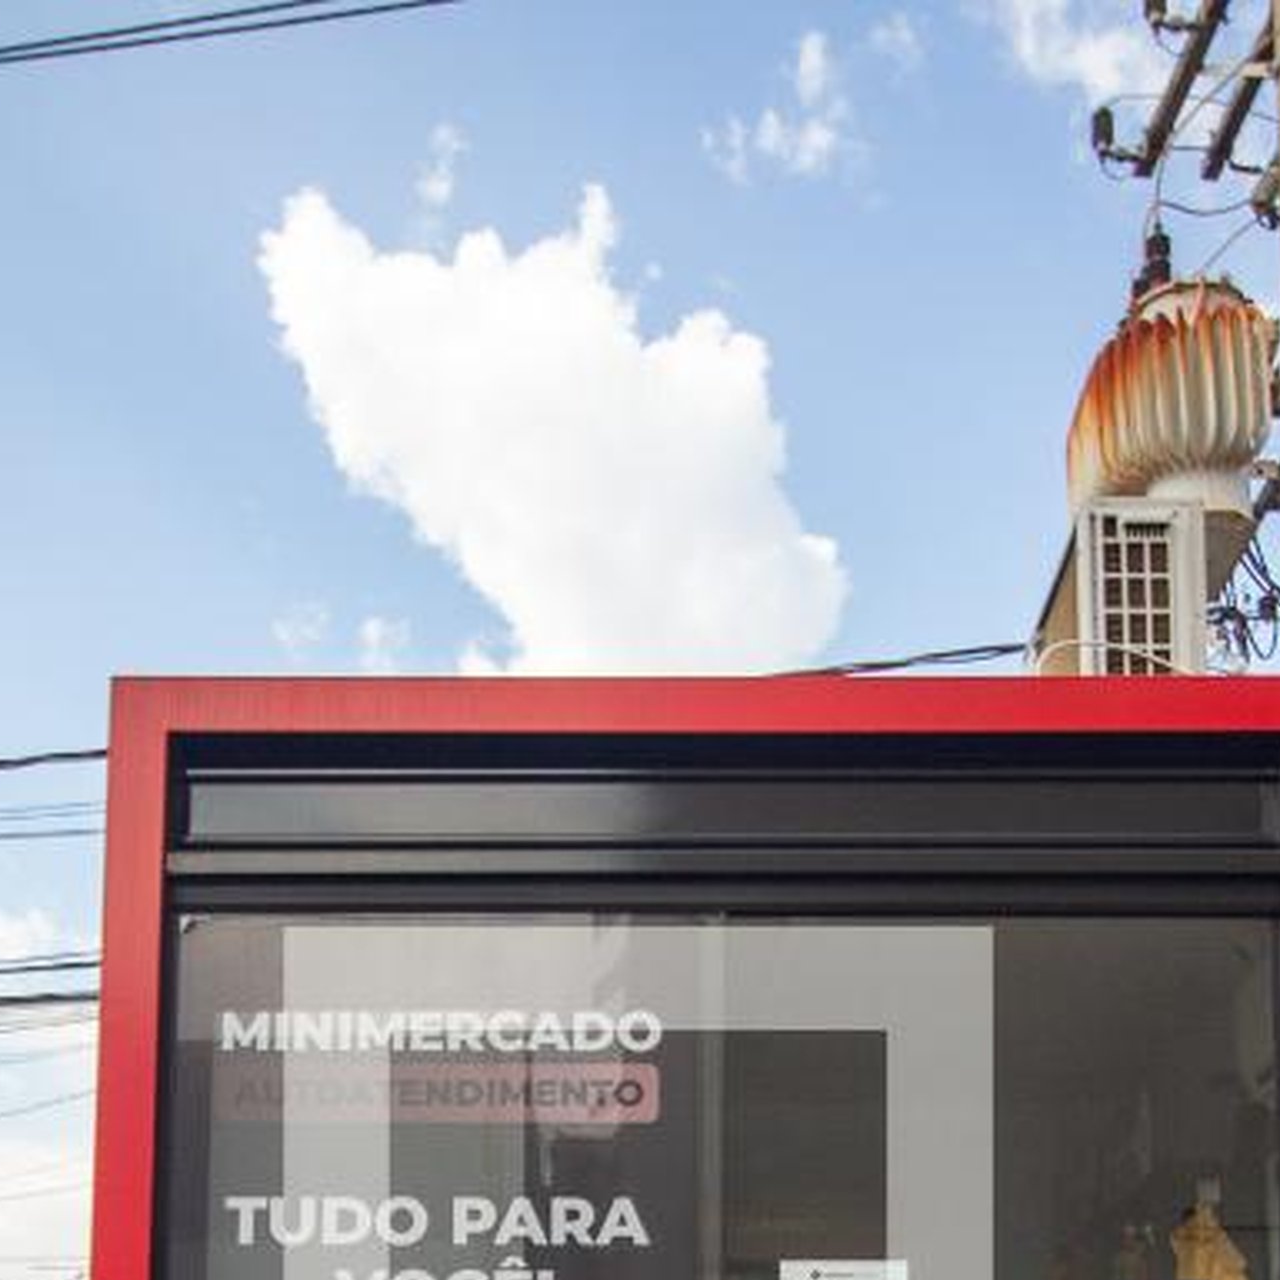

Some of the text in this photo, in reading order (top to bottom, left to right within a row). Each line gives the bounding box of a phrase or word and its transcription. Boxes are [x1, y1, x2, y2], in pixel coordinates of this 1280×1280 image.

[220, 1010, 662, 1052] MINIMERCADO
[225, 1196, 650, 1247] TUDO PARA
